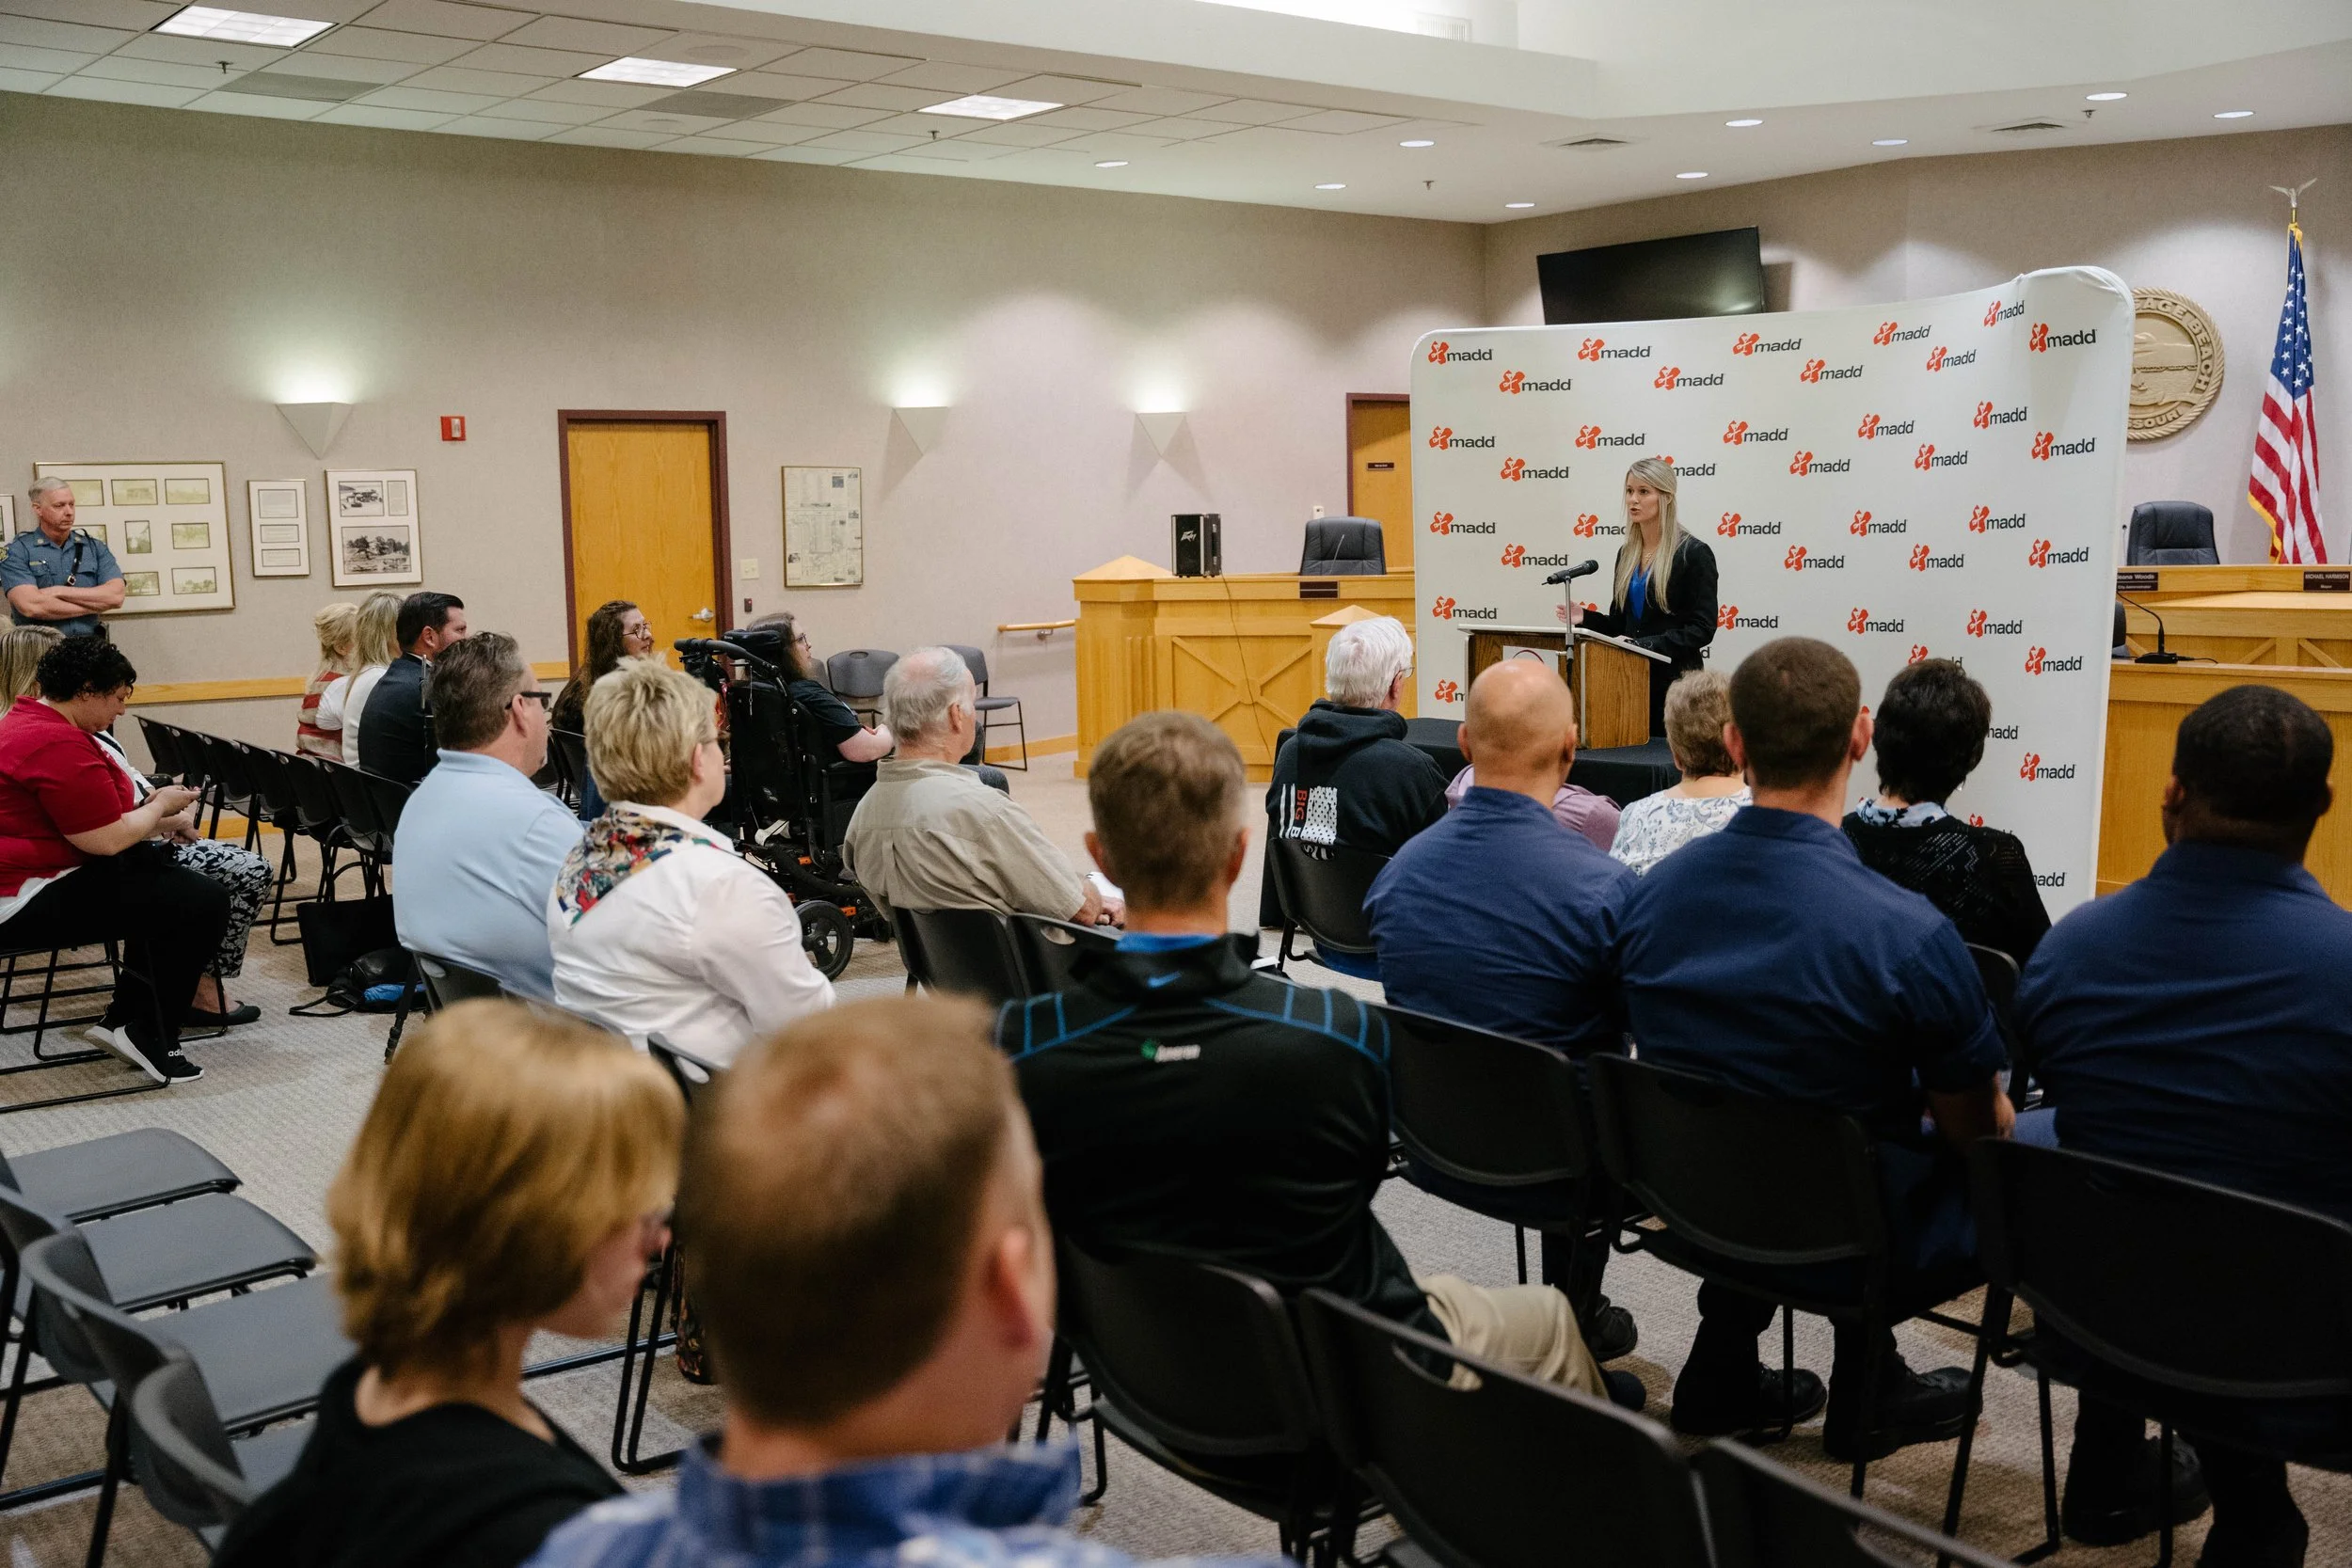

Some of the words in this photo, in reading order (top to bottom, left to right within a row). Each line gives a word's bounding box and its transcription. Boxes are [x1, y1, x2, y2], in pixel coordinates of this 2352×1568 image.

[1996, 300, 2025, 322] madd
[1891, 325, 1931, 342] madd
[2046, 328, 2097, 349] madd
[1600, 345, 1651, 359] madd
[1754, 338, 1802, 354] madd
[1446, 348, 1494, 363] madd
[1942, 349, 1977, 368] madd
[2187, 321, 2214, 391] BEACH
[1676, 373, 1724, 388] madd
[1820, 364, 1864, 381] madd
[1521, 378, 1572, 392] madd
[1989, 406, 2027, 425] madd
[1743, 428, 1789, 443] madd
[1875, 420, 1915, 436] madd
[1449, 436, 1496, 449] madd
[1597, 433, 1646, 447] madd
[2049, 437, 2096, 458] madd
[1808, 458, 1851, 474] madd
[1931, 450, 1968, 467] madd
[1521, 466, 1570, 480] madd
[1674, 463, 1717, 477] madd
[1450, 521, 1497, 534] madd
[1737, 521, 1782, 536] madd
[1867, 518, 1907, 534] madd
[1986, 513, 2026, 531] madd
[1521, 553, 1569, 567] madd
[1804, 555, 1846, 570] madd
[1926, 553, 1965, 570] madd
[2046, 546, 2090, 565] madd
[1452, 607, 1498, 620] madd
[1735, 614, 1778, 629] madd
[1865, 618, 1905, 633] madd
[1983, 620, 2023, 635] madd
[2042, 656, 2084, 672] madd
[2036, 763, 2076, 780] madd
[1295, 789, 1309, 821] BIG
